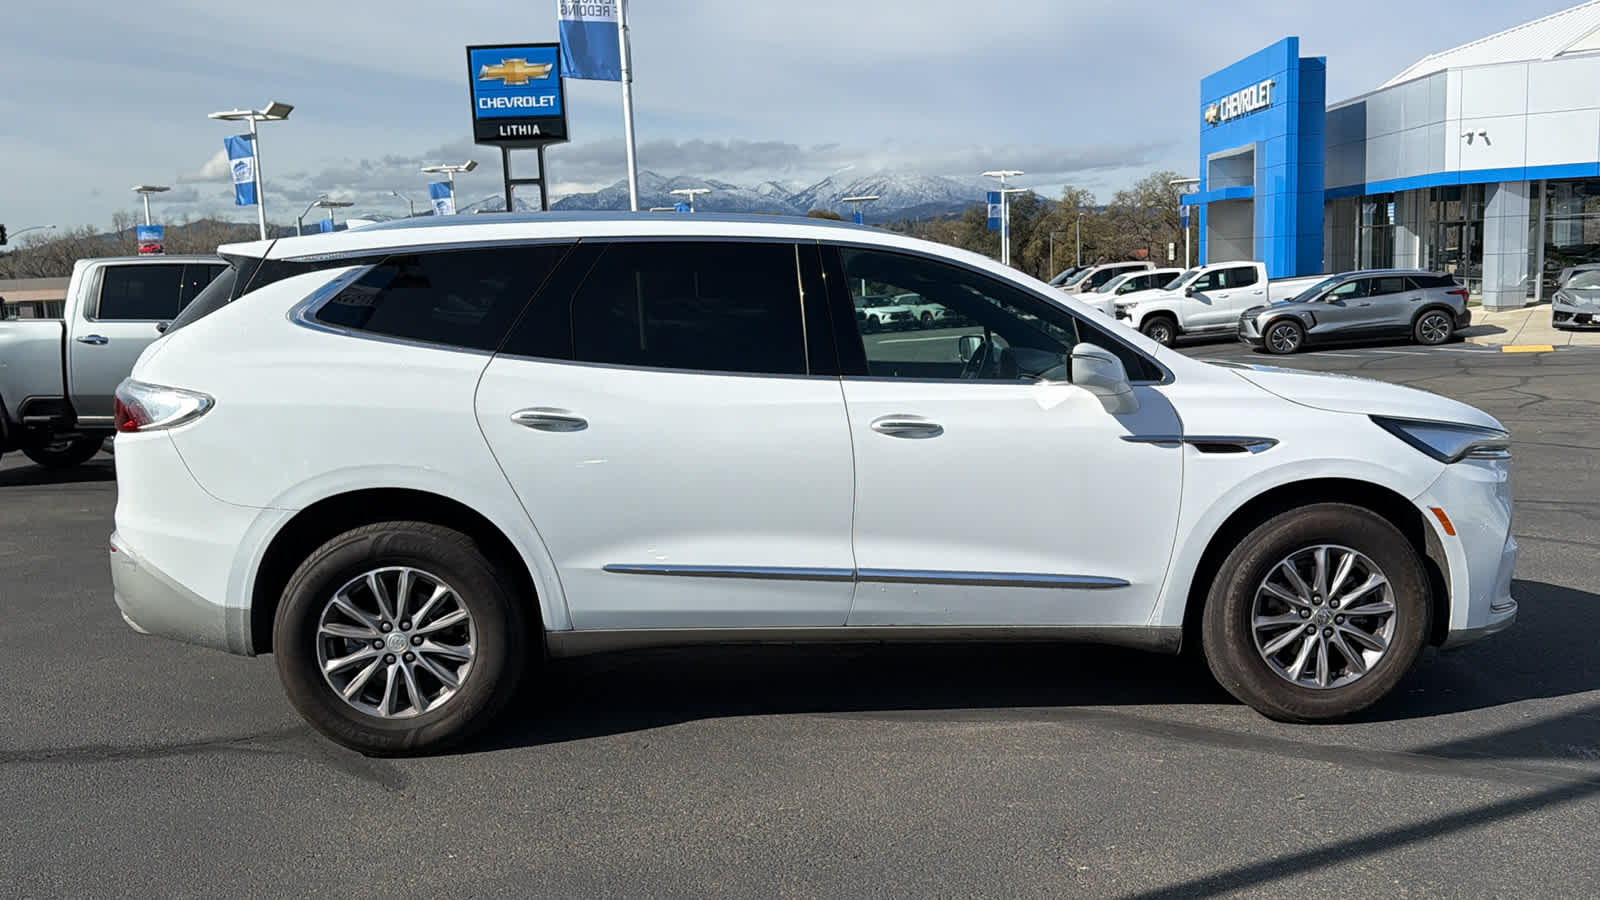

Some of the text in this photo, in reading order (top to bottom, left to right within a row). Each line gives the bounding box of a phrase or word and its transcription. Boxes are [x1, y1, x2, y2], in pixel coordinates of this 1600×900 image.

[479, 95, 555, 109] CHEVROLET
[1220, 79, 1272, 121] CHEVROLET
[499, 124, 541, 137] LITHIA
